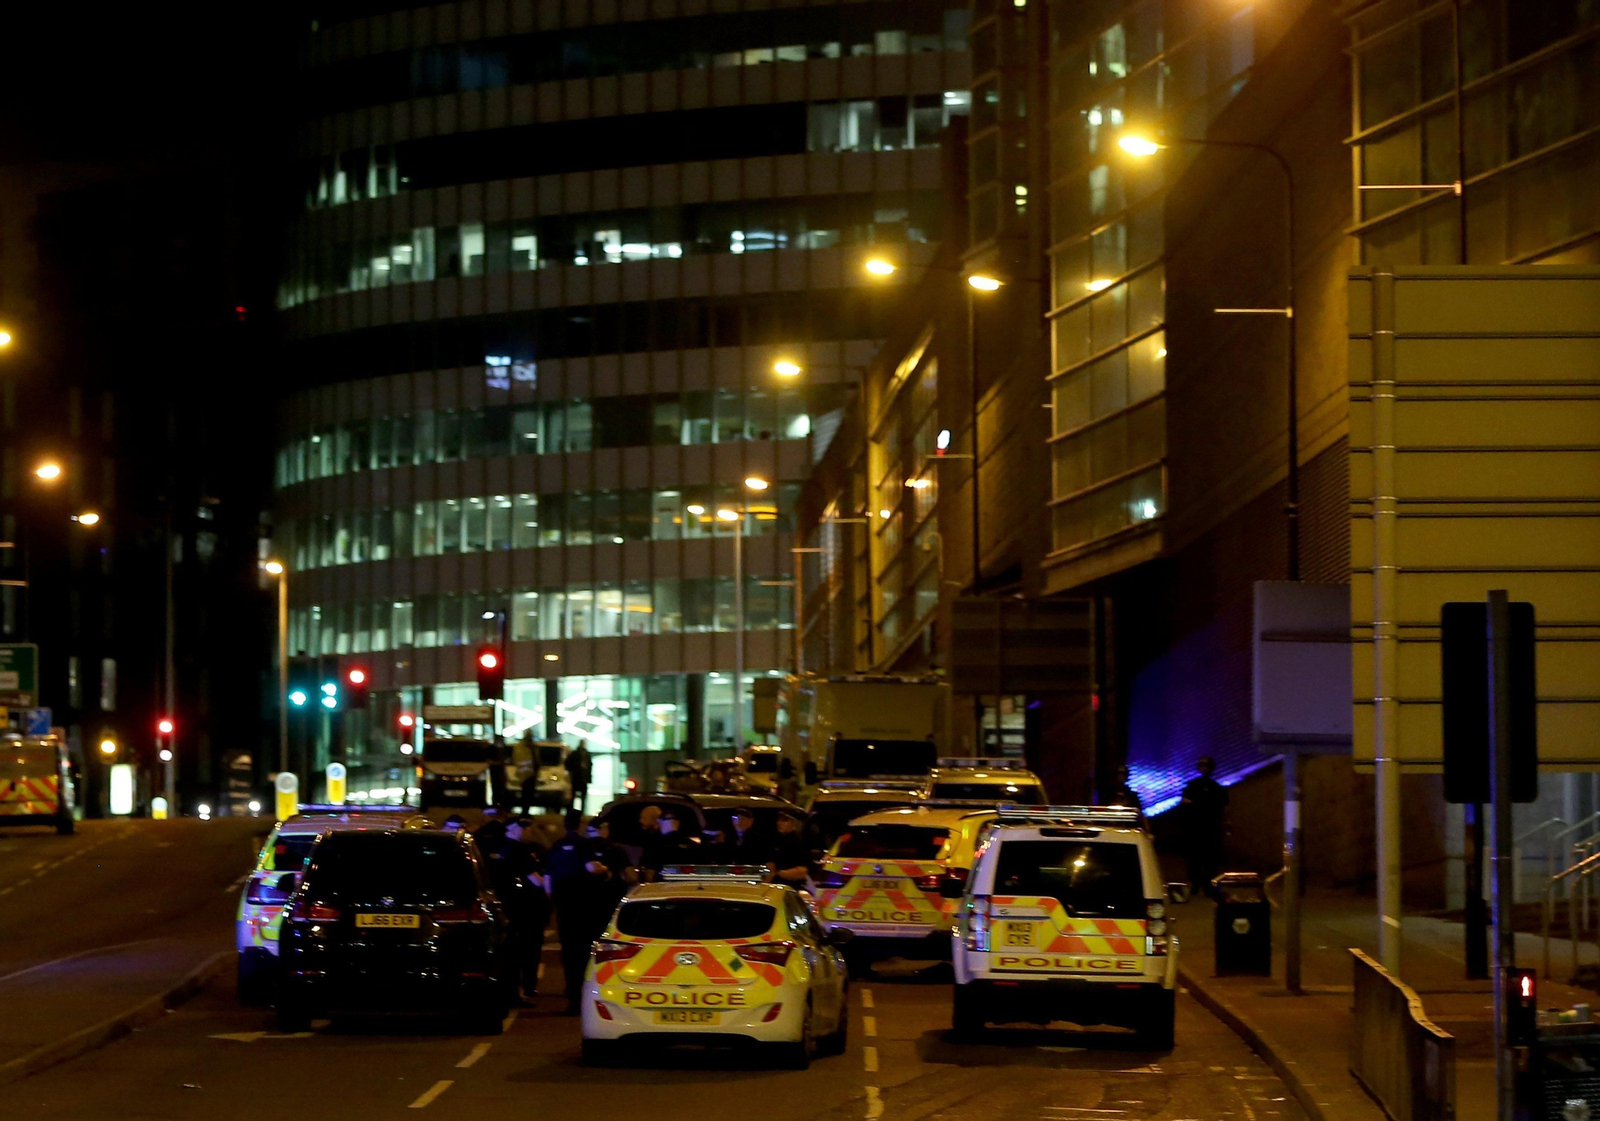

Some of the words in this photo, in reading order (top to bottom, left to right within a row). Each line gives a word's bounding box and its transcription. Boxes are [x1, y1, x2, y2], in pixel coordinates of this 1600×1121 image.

[360, 915, 389, 926] LJ66
[392, 915, 414, 926] EXR
[836, 910, 922, 921] POLICE
[1008, 934, 1030, 945] CYS
[1000, 957, 1136, 969] POLICE
[625, 992, 745, 1006] POLICE
[690, 1011, 713, 1023] CXP
